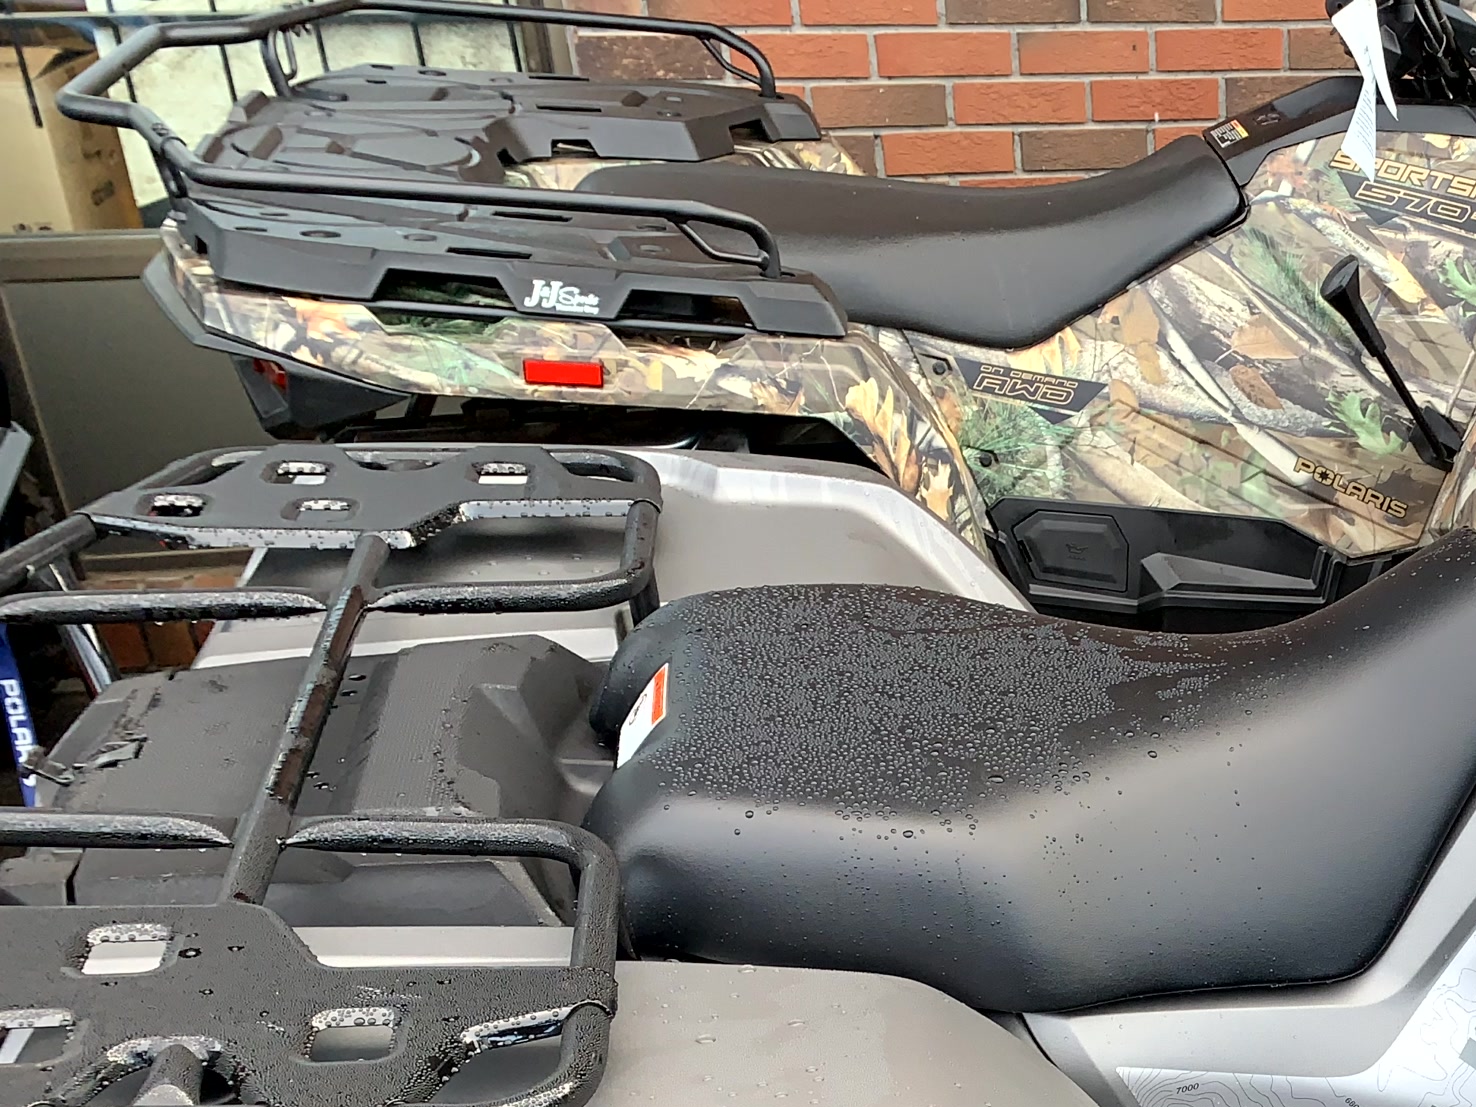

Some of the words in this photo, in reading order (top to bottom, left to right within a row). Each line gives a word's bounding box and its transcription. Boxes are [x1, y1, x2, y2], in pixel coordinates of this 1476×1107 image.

[1355, 180, 1472, 223] 570
[973, 373, 1075, 405] AWD
[980, 364, 1004, 375] ON
[1010, 371, 1079, 389] DEMAND
[1293, 456, 1409, 519] POLARIS
[1176, 1082, 1200, 1095] 7000
